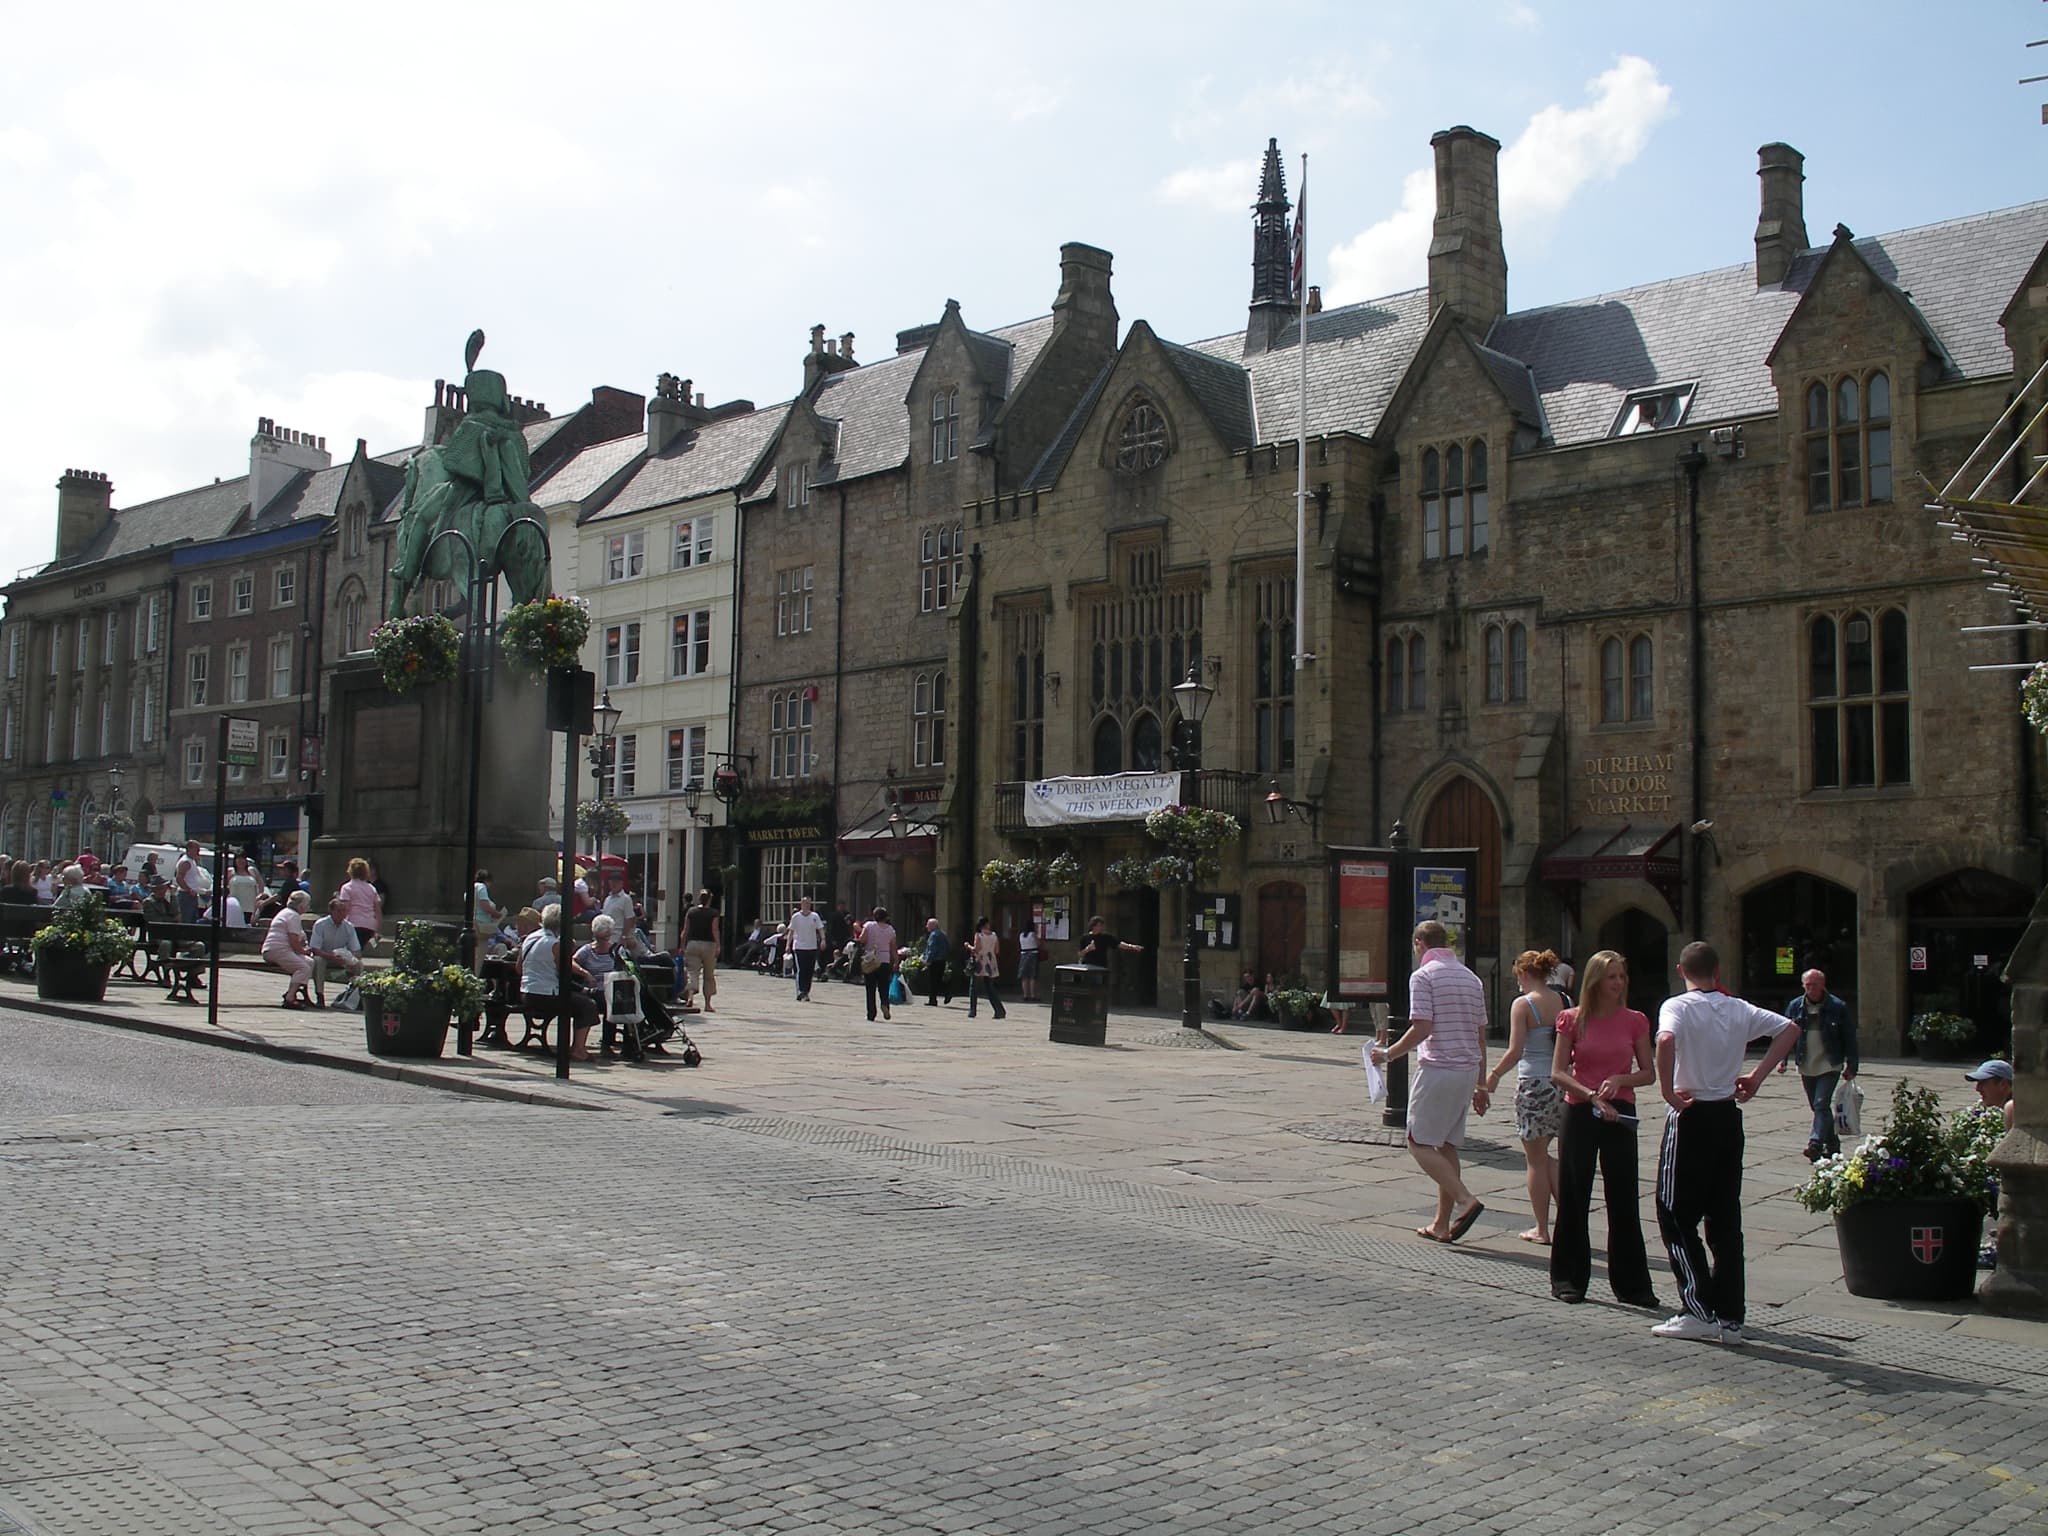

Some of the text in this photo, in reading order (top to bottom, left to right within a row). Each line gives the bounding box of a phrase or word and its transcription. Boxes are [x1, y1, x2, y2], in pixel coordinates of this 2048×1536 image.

[1584, 753, 1673, 776] DURHAM
[1056, 775, 1176, 796] DURHAM REGATTA
[1590, 774, 1668, 794] INDOOR
[1065, 796, 1163, 813] THIS WEEKEND
[1584, 794, 1672, 816] MARKET
[223, 811, 265, 827] usic zone
[748, 826, 821, 841] MARKET TAVERN
